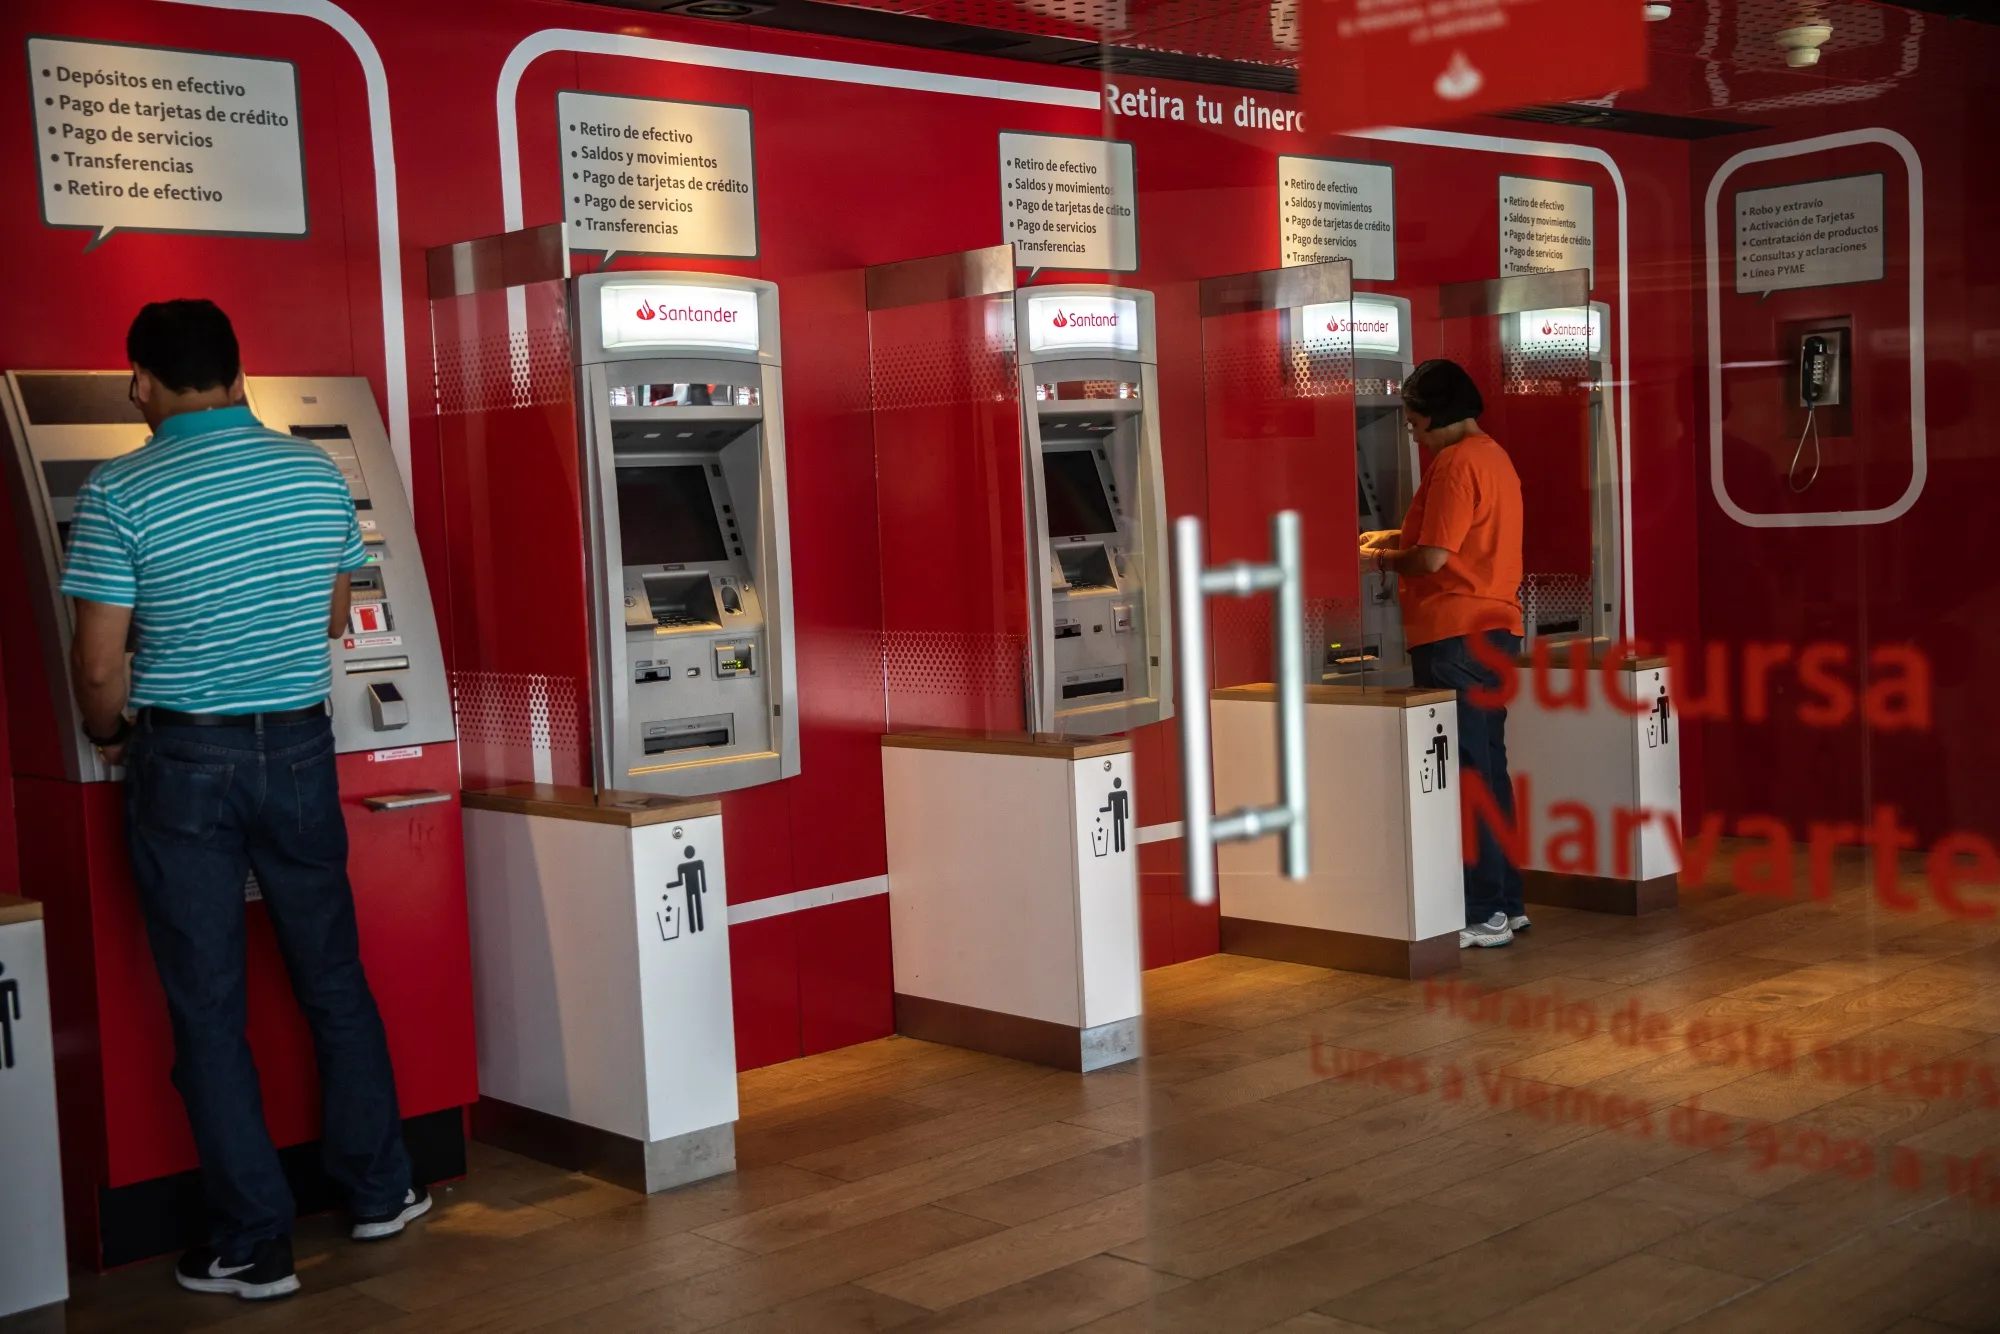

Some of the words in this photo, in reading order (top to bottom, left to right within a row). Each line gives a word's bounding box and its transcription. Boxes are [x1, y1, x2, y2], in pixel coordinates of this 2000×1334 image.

[56, 66, 147, 89] Depósitos
[152, 74, 172, 90] en
[177, 77, 245, 97] efectivo
[59, 95, 104, 116] Pago
[109, 97, 130, 116] de
[135, 101, 202, 124] tarjetas
[206, 104, 226, 123] de
[230, 107, 289, 128] crédito
[1105, 83, 1184, 121] Retira
[1196, 94, 1222, 125] tu
[62, 123, 107, 145] Pago
[111, 125, 132, 143] de
[137, 128, 213, 148] servicios
[580, 122, 621, 138] Retiro
[624, 125, 639, 139] de
[642, 126, 693, 144] efectivo
[64, 151, 194, 174] Transferencias
[581, 146, 624, 162] Saldos
[626, 150, 634, 166] y
[637, 152, 718, 169] movimientos
[1014, 157, 1044, 171] Retiro
[1046, 160, 1057, 171] de
[1059, 161, 1097, 175] efectivo
[68, 179, 123, 199] Retiro
[128, 182, 149, 200] de
[153, 183, 223, 203] efectivo
[583, 170, 615, 188] Pago
[618, 172, 634, 186] de
[637, 173, 685, 191] tarjetas
[688, 177, 703, 191] de
[705, 178, 749, 194] crédito
[1015, 178, 1046, 191] Saldos
[1047, 182, 1054, 195] y
[1055, 182, 1115, 196] movimientos
[1290, 178, 1315, 191] Retiro
[1316, 181, 1325, 192] de
[1327, 181, 1358, 195] efectivo
[584, 193, 616, 211] Pago
[619, 195, 635, 209] de
[638, 198, 693, 213] servicios
[1016, 198, 1040, 214] Pago
[1041, 200, 1053, 212] de
[1055, 201, 1091, 216] tarjetas
[1092, 203, 1104, 215] de
[1291, 197, 1316, 209] Saldos
[1317, 200, 1323, 212] y
[1323, 201, 1372, 213] movimientos
[1509, 195, 1529, 207] Retiro
[1530, 197, 1538, 208] de
[1539, 199, 1565, 212] efectivo
[1749, 206, 1773, 216] Robo
[1776, 205, 1782, 215] y
[1783, 198, 1824, 212] extravío
[585, 217, 679, 235] Transferencias
[1017, 219, 1041, 234] Pago
[1042, 220, 1054, 232] de
[1056, 222, 1097, 234] servicios
[1291, 215, 1311, 229] Pago
[1312, 216, 1322, 227] de
[1323, 217, 1352, 231] tarjetas
[1354, 219, 1363, 230] de
[1364, 220, 1391, 232] crédito
[1509, 212, 1530, 224] Saldos
[1530, 217, 1535, 227] y
[1536, 217, 1576, 229] movimientos
[1749, 217, 1799, 232] Activación
[1802, 215, 1813, 225] de
[1815, 211, 1855, 225] Tarjetas
[1292, 233, 1312, 248] Pago
[1313, 234, 1323, 245] de
[1324, 236, 1357, 248] servicios
[1509, 229, 1525, 242] Pago
[1526, 231, 1534, 241] de
[1535, 232, 1560, 244] tarjetas
[1560, 233, 1568, 244] de
[1569, 235, 1591, 246] crédito
[1749, 231, 1812, 247] Contratación
[1814, 229, 1825, 240] de
[1827, 224, 1879, 241] productos
[1017, 239, 1086, 253] Transferencias
[1509, 246, 1526, 259] Pago
[1526, 247, 1534, 257] de
[1535, 248, 1563, 259] servicios
[1750, 248, 1796, 263] Consultas
[1797, 249, 1804, 260] y
[1805, 242, 1867, 256] aclaraciones
[1777, 263, 1805, 275] PYME
[659, 304, 738, 323] Santander
[1465, 632, 1932, 731] Sucursa
[1459, 768, 2000, 918] Narvarte
